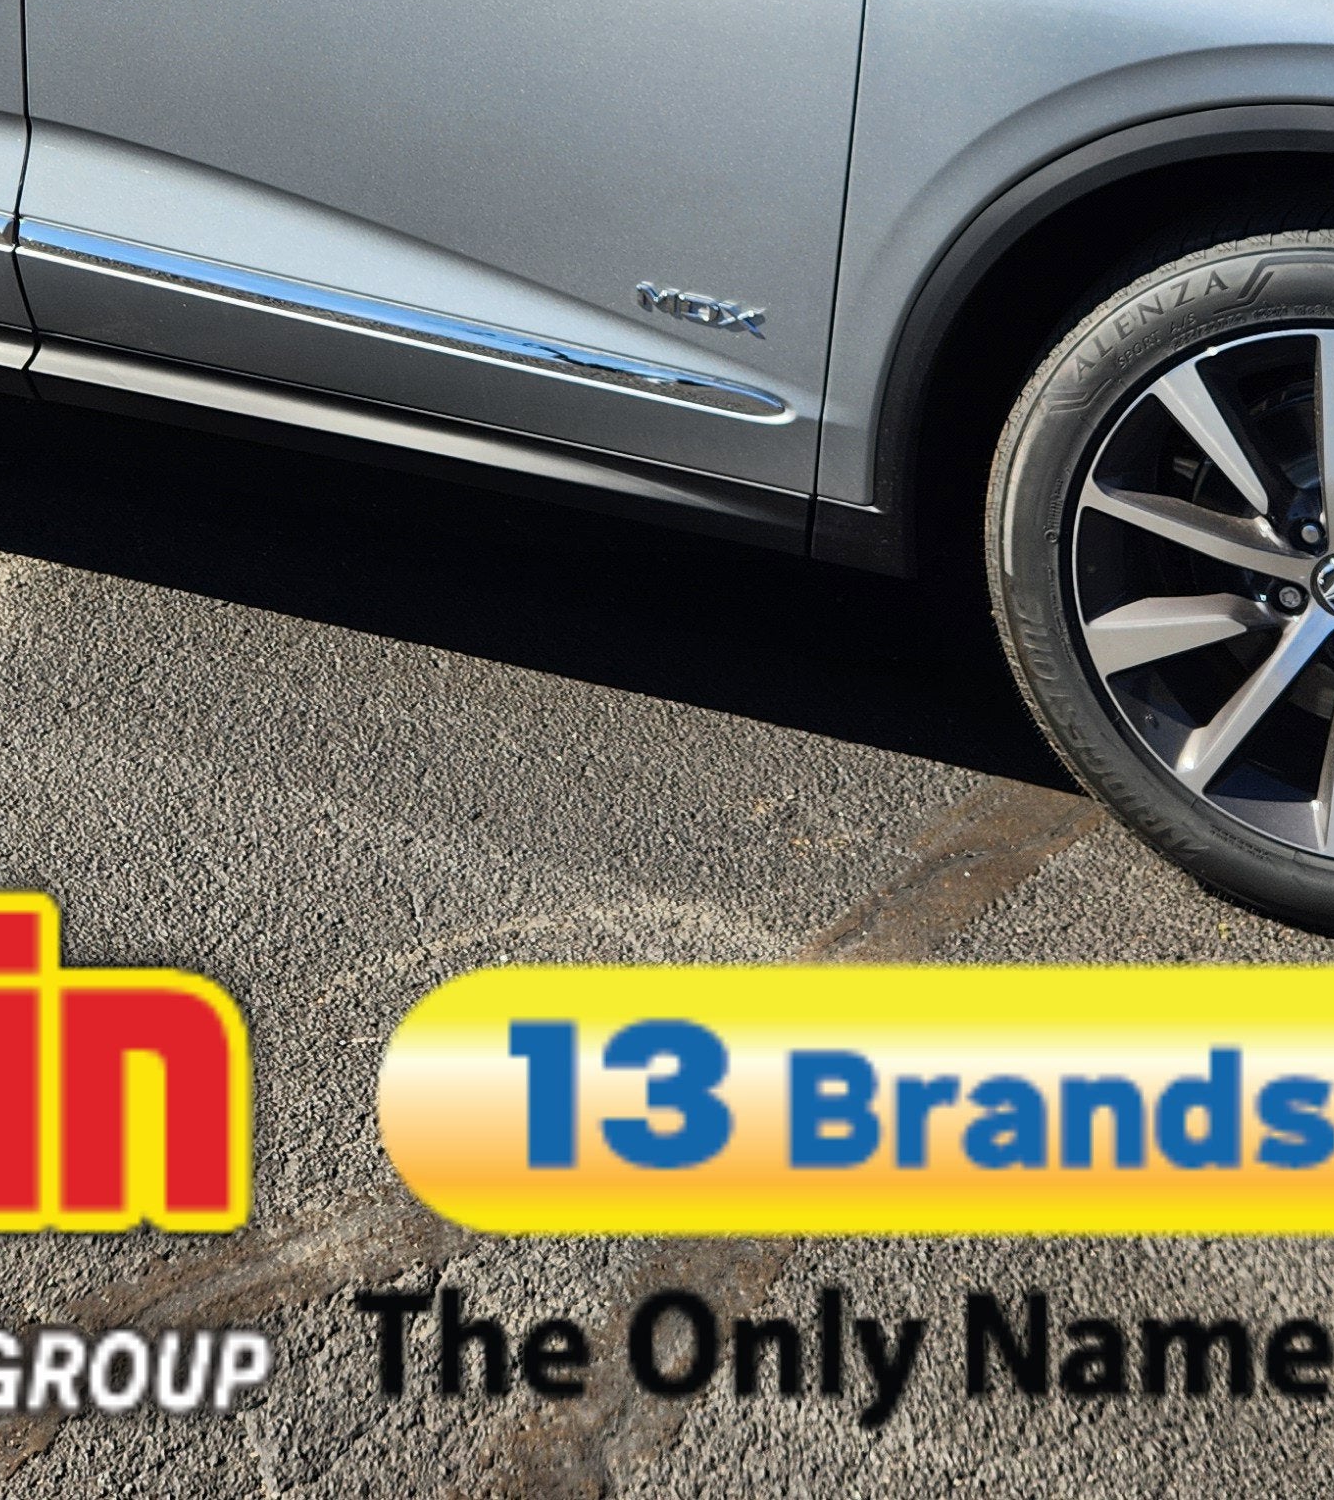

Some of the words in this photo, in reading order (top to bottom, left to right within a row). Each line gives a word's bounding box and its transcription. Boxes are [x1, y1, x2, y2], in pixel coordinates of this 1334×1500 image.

[635, 280, 767, 340] MDX
[1072, 268, 1229, 383] ALENZA
[1117, 328, 1162, 370] SPORT
